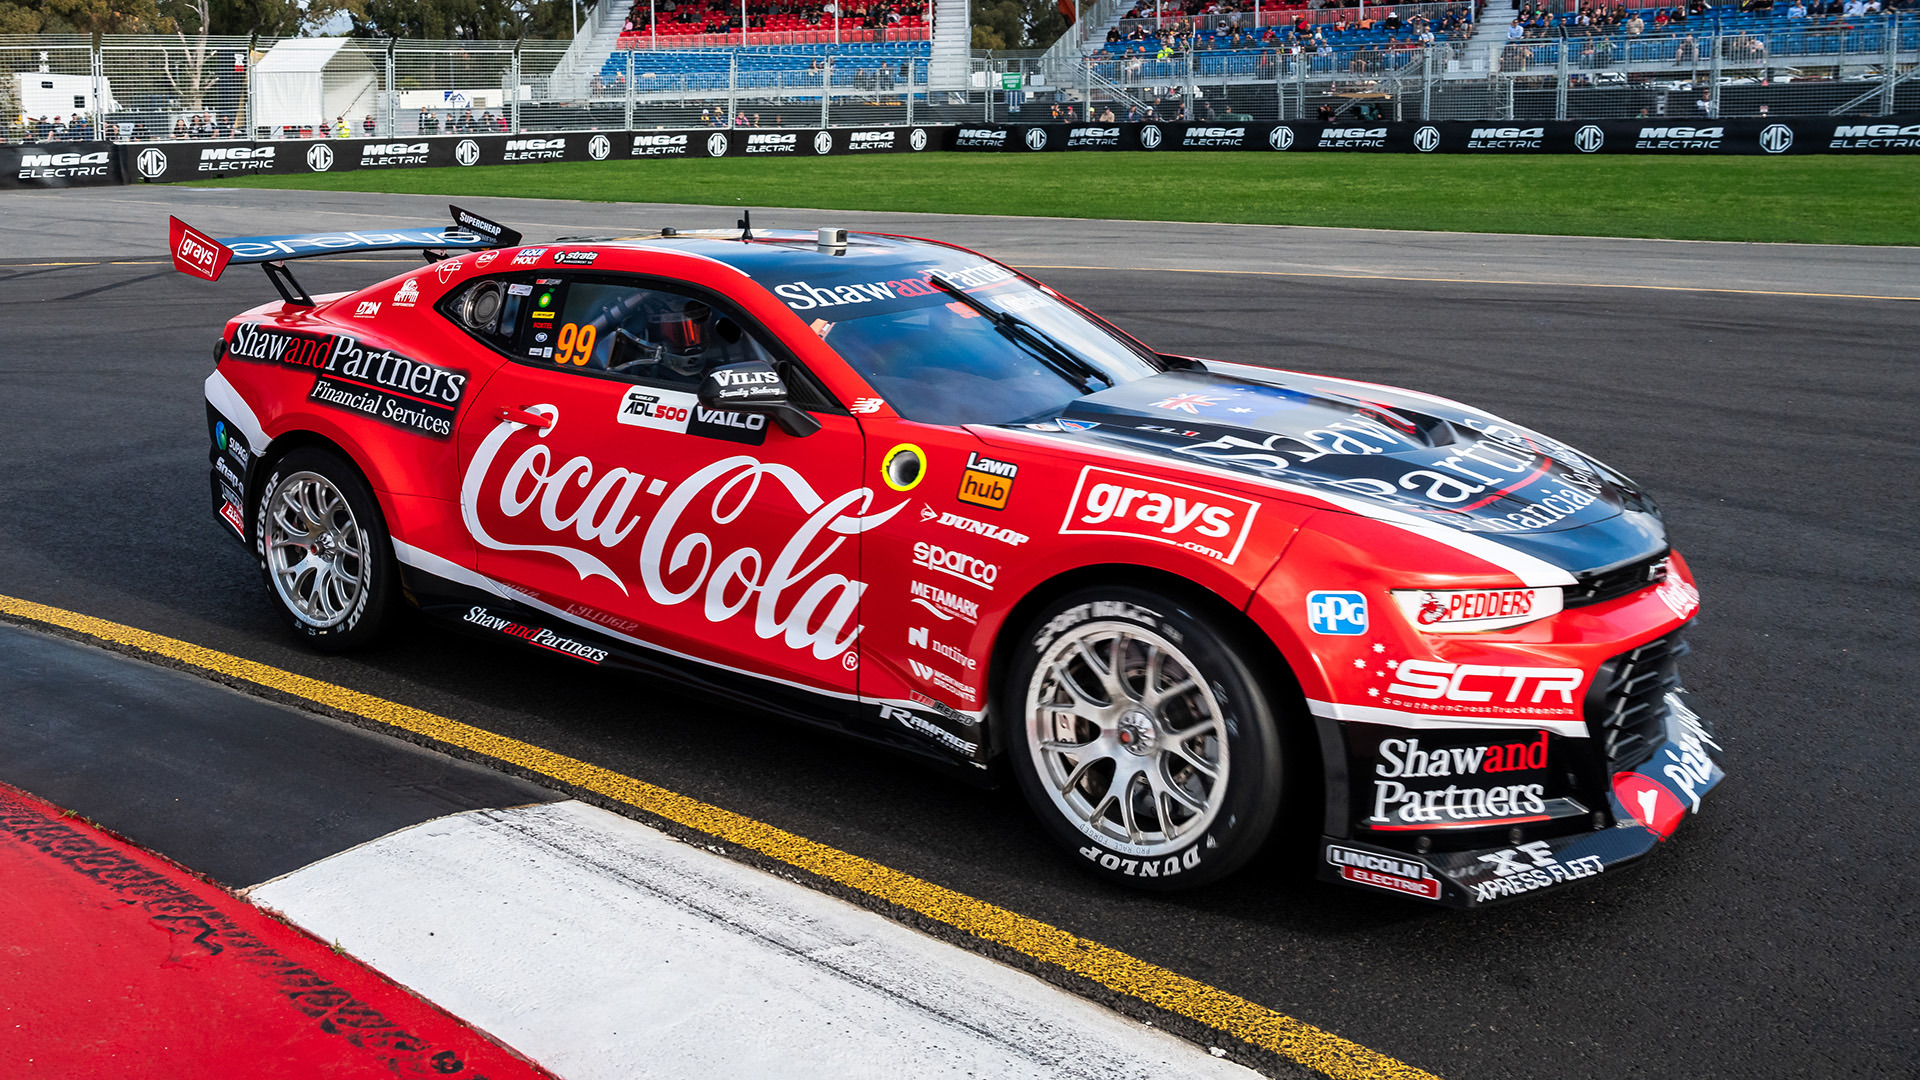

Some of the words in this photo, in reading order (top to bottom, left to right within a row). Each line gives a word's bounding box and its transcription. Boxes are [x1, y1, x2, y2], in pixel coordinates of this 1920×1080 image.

[851, 131, 895, 141] MG4
[958, 129, 1006, 139] MG4
[1070, 128, 1120, 137] MG4
[1186, 128, 1245, 137] MG4
[1321, 128, 1387, 138] MG4
[1471, 128, 1544, 138] MG4
[1639, 127, 1724, 138] MG4
[506, 139, 565, 150] MG4
[634, 135, 688, 146] MG4
[748, 134, 796, 144] MG4
[849, 141, 893, 149] ELECTRIC
[956, 138, 1004, 147] ELECTRIC
[1067, 138, 1118, 146] ELECTRIC
[1183, 138, 1243, 146] ELECTRIC
[1318, 139, 1384, 148] ELECTRIC
[1467, 140, 1542, 148] ELECTRIC
[1635, 140, 1721, 149] ELECTRIC
[201, 147, 275, 159] MG4
[363, 143, 429, 155] MG4
[631, 146, 686, 155] ELECTRIC
[746, 144, 795, 153] ELECTRIC
[21, 152, 110, 166] MG4
[360, 156, 428, 166] ELECTRIC
[504, 151, 564, 161] ELECTRIC
[198, 160, 274, 171] ELECTRIC
[19, 167, 108, 178] ELECTRIC
[460, 211, 501, 236] SUPERCHEAP
[181, 238, 214, 265] grays
[566, 251, 598, 260] strata
[513, 256, 540, 265] MOLY
[554, 322, 597, 366] 99
[311, 380, 382, 414] Financial
[382, 399, 451, 435] Services
[696, 406, 766, 430] VAILO
[966, 451, 1018, 478] Lawn
[963, 475, 1005, 501] hub
[1081, 482, 1235, 538] grays
[460, 403, 912, 660] Coca-Cola
[937, 512, 1030, 546] DUNLOP
[1177, 541, 1226, 560] .com
[912, 541, 998, 583] sparco
[911, 580, 979, 619] METAMARK
[1450, 588, 1536, 620] PEDDERS
[1311, 596, 1366, 632] PPG
[1387, 659, 1584, 704] SCTR
[879, 702, 979, 753] RAMPAGE
[1370, 779, 1546, 824] Partners
[1080, 823, 1108, 845] FORGED
[1079, 844, 1201, 878] DUNLOP
[1333, 849, 1423, 879] LINCOLN
[1353, 871, 1430, 894] ELECTRIC
[1471, 864, 1551, 902] XPRESS
[1549, 855, 1605, 885] FLEET
